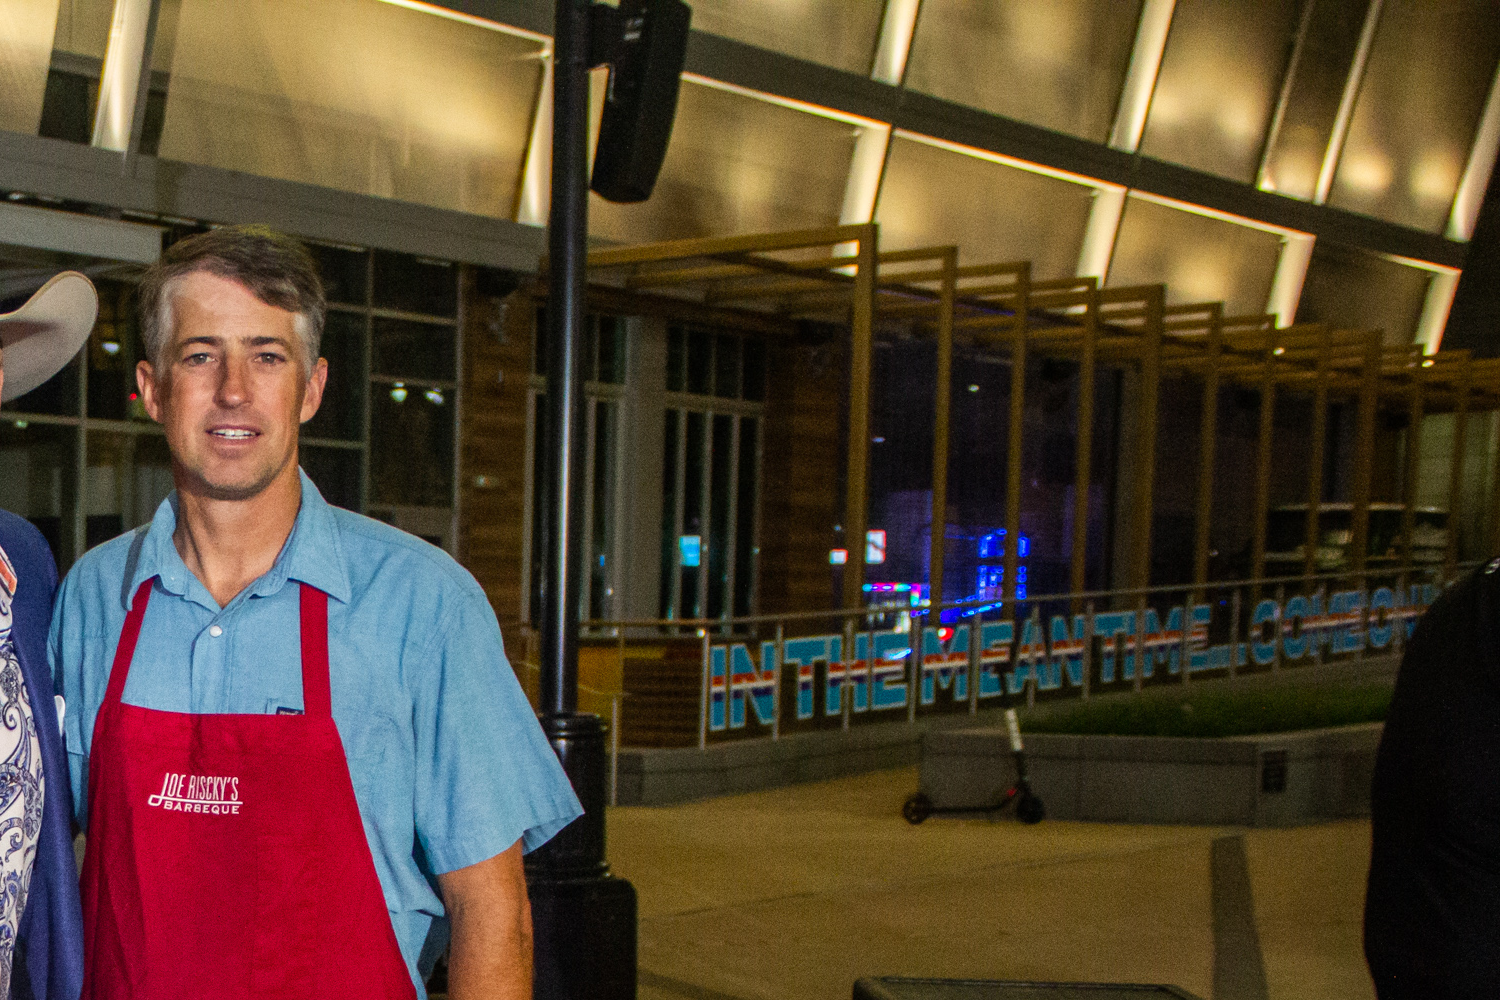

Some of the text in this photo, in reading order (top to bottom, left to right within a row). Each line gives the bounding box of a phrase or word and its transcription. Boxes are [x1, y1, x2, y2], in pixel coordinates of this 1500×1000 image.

[709, 641, 780, 731] IN
[782, 631, 911, 721] THE
[148, 772, 239, 806] JOE RISCKY'S
[163, 801, 240, 815] BARBEQUE
